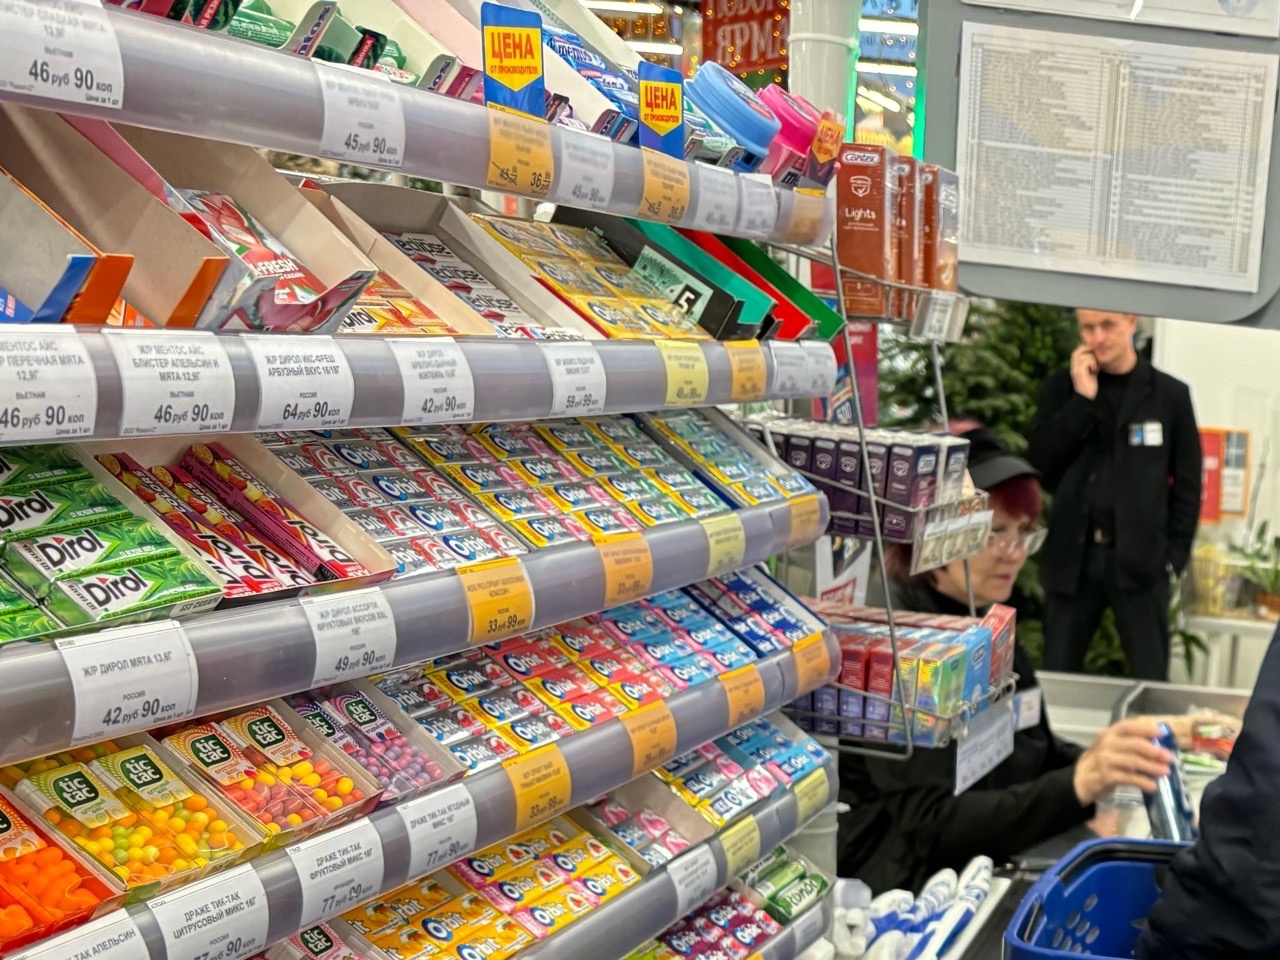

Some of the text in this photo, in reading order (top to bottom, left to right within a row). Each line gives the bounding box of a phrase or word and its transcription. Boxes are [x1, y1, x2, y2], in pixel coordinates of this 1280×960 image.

[491, 32, 534, 63] ЦЕНА
[29, 59, 94, 90] 46 руб 90
[644, 85, 677, 112] ЦЕНА
[345, 133, 386, 154] 45 90
[845, 207, 876, 220] Lights
[60, 355, 84, 366] МЯТА
[132, 359, 169, 368] БЛИСТЕР
[159, 372, 181, 381] МЯТА
[268, 365, 321, 376] АРБУЗНЫЙ ВКУС
[154, 404, 209, 423] 46 руб 90
[283, 402, 328, 420] 64 руб 90
[422, 396, 456, 413] 42 90
[0, 405, 84, 429] 46 руб 90 коп
[341, 445, 387, 467] Orbit
[0, 490, 55, 529] Dirol
[416, 507, 459, 527] Orbit
[36, 528, 105, 568] Dirol
[449, 536, 491, 558] Orbit
[83, 569, 149, 607] Dirol
[488, 614, 517, 633] 33 99
[100, 655, 153, 676] ДИРОЛ МЯТА
[335, 650, 375, 671] 49 90
[509, 652, 545, 673] Orbit
[451, 670, 487, 689] Orbit
[546, 679, 578, 696] Orbit
[122, 690, 146, 700] РОССИЯ
[102, 699, 176, 726] 42 руб 90 коп
[250, 721, 275, 736] tic
[255, 730, 283, 745] tac
[195, 739, 220, 754] tic
[199, 748, 228, 763] tac
[59, 777, 84, 794] tic
[62, 787, 96, 804] tac
[316, 852, 338, 867] ДРАЖЕ
[427, 850, 438, 866] 77
[475, 855, 507, 874] Orbit
[557, 849, 588, 869] Orbit
[309, 859, 347, 880] ФРУКТОВЫЙ
[504, 878, 537, 897] Orbit
[588, 874, 617, 894] Orbit
[184, 891, 241, 923] ДРАЖЕ ТИК-ТАК
[323, 895, 336, 913] 77
[535, 903, 567, 923] Orbit
[173, 902, 245, 939] ЦИТРУСОВЫЙ МИКС
[428, 913, 469, 939] Orbit
[92, 928, 136, 956] АПЕЛЬСИН
[303, 929, 324, 943] tic
[308, 939, 331, 952] tac
[226, 937, 241, 957] 90
